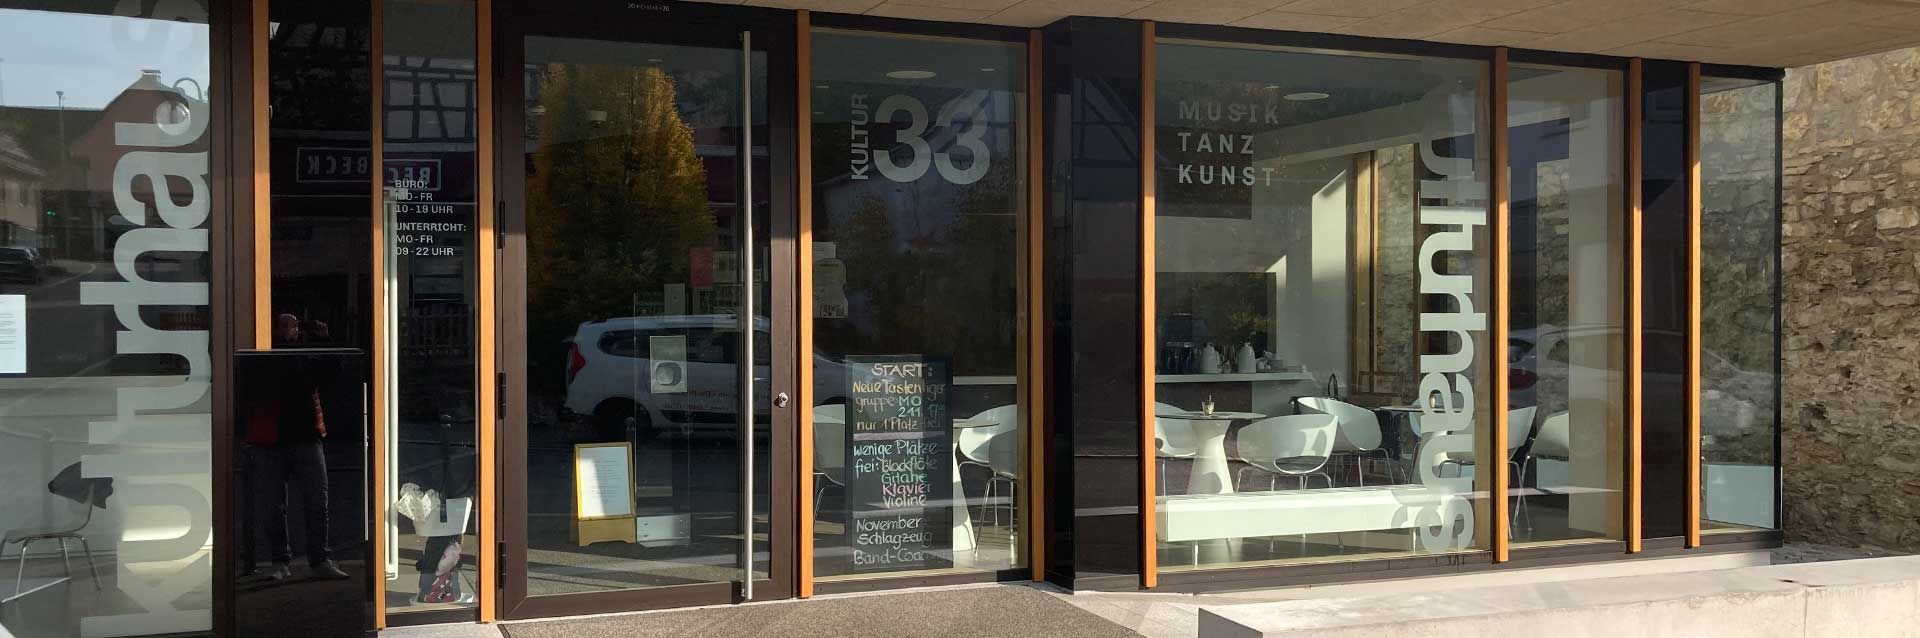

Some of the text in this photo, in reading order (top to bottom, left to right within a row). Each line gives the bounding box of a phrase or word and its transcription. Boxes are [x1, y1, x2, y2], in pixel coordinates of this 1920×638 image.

[1178, 99, 1279, 124] MUSIK
[851, 93, 869, 180] KULTUR
[873, 94, 990, 184] 33
[1178, 132, 1254, 154] TANZ
[1178, 164, 1275, 186] KUNST
[431, 205, 454, 214] UHR
[395, 222, 467, 232] UNTERRICHT:
[431, 248, 454, 256] UHR
[853, 380, 881, 393] Neue
[855, 396, 921, 413] gruppe MO
[856, 421, 876, 430] nur
[890, 417, 919, 431] Platz
[853, 443, 892, 461] wenige
[854, 458, 879, 480] frei:
[882, 484, 931, 496] Klavier
[882, 494, 927, 508] Violine
[856, 531, 933, 549] Schlagzeug
